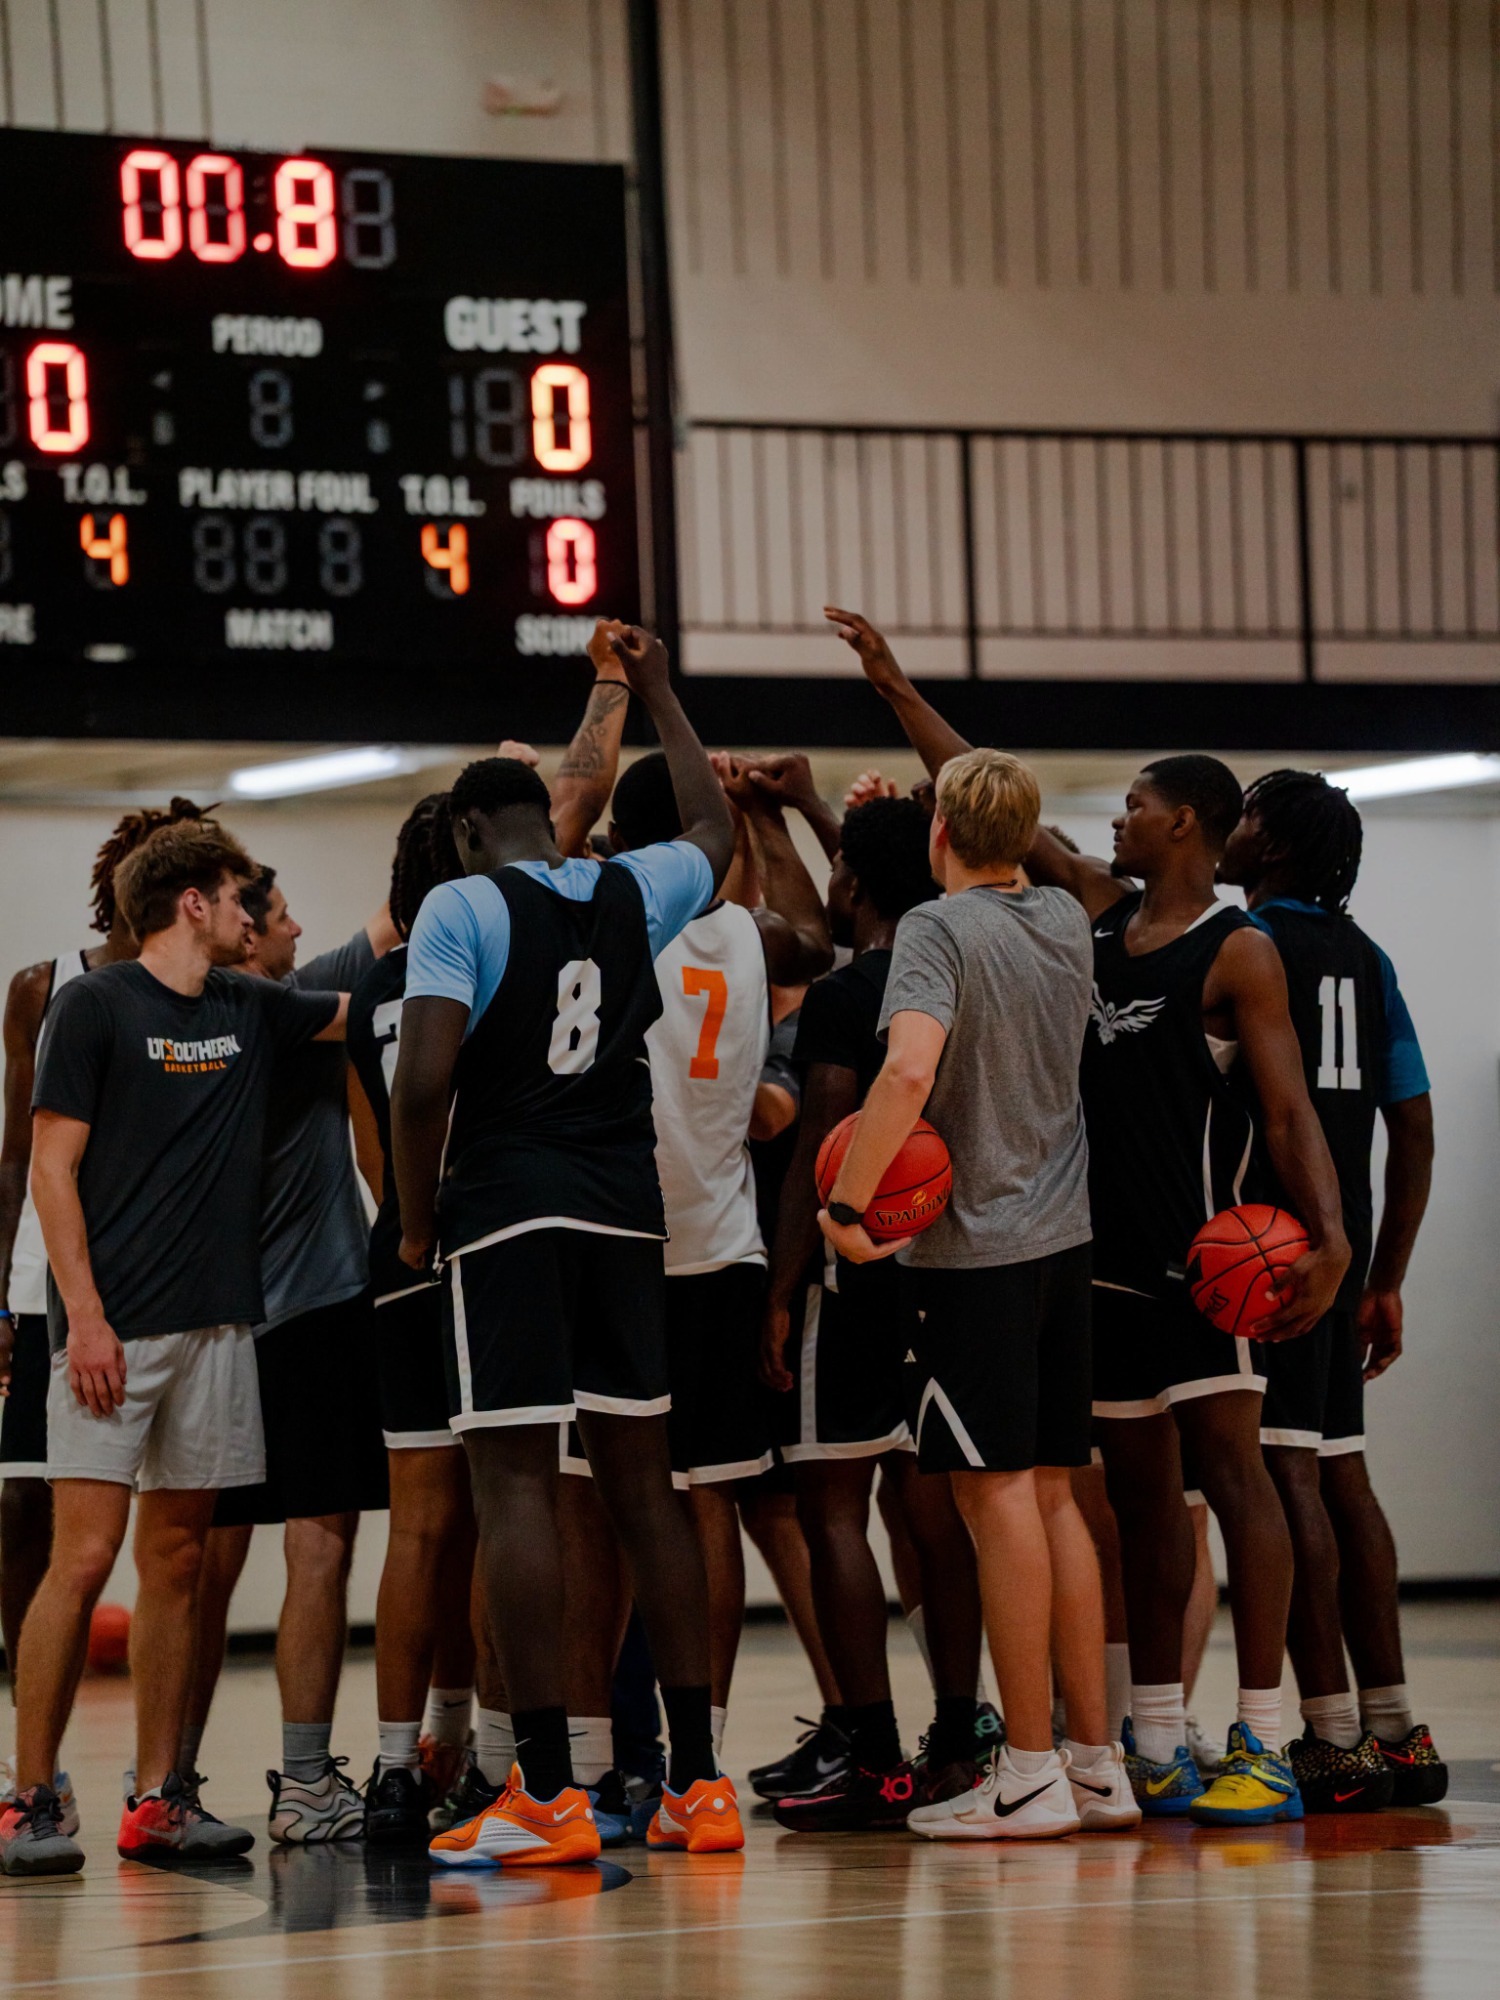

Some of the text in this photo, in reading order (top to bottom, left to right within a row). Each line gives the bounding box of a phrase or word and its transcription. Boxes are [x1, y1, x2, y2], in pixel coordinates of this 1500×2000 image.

[0, 272, 75, 330] ME
[212, 313, 324, 358] PERIOD
[444, 295, 588, 354] GUEST
[26, 342, 90, 454] 0
[530, 363, 592, 473] 0
[179, 466, 380, 514] PLAYER FOUL
[509, 477, 606, 520] FOULS
[80, 512, 130, 587] 4
[420, 522, 470, 596] 4
[546, 516, 598, 606] 0
[224, 607, 335, 652] MATCH
[547, 957, 602, 1075] 8
[681, 965, 729, 1080] 7
[1317, 975, 1362, 1090] 11
[164, 1060, 227, 1074] BASKETBALL
